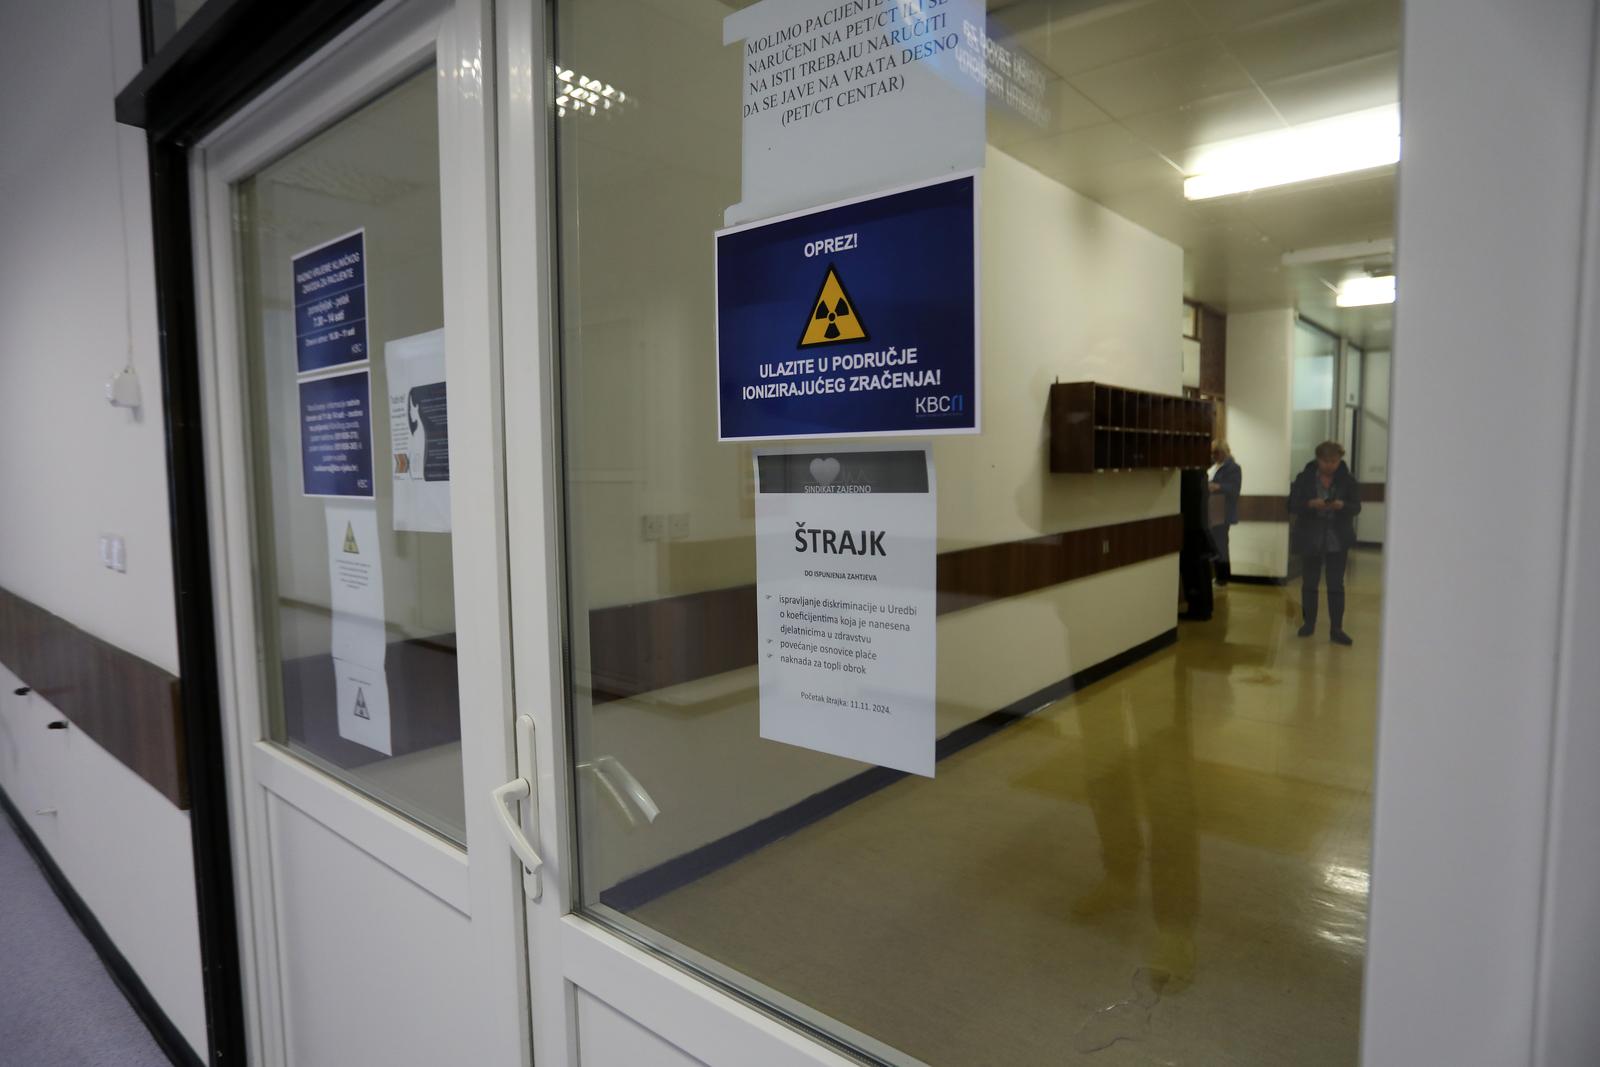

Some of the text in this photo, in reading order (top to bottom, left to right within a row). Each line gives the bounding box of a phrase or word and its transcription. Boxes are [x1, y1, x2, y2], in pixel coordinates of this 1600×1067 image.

[748, 24, 802, 56] MOLIMO
[749, 38, 817, 76] NARUČENI
[821, 30, 841, 48] NA
[846, 7, 898, 39] PET/CT
[751, 12, 946, 95] NA ISTI TREBAJU NARUČITI
[743, 33, 959, 118] DA SE JAVE NA VRATA DESNO
[781, 74, 905, 128] (PET/CT CENTAR)
[804, 233, 858, 258] OPREZ!
[760, 346, 918, 379] ULAZITE U PODRUČJE
[743, 368, 941, 400] IONIZIRAJUĆEG ZRAČENJA!
[804, 484, 872, 494] SINDIKAT ZAJEDNO
[795, 521, 887, 557] ŠTRAJK
[804, 570, 878, 582] DO ISPUNJENJA ZAHTJEVA
[779, 594, 918, 617] ispravljanje diskriminacije u Uredbi
[779, 609, 911, 632] o koeficijentima koja je nanesena
[780, 624, 872, 644] djelatnicima u zdravstvu
[780, 640, 818, 654] povećanje
[819, 646, 854, 657] osnovice
[780, 654, 867, 675] naknada za topli obrok
[800, 691, 825, 704] Početak
[825, 696, 849, 708] štrajka:
[850, 700, 871, 712] 11.11.
